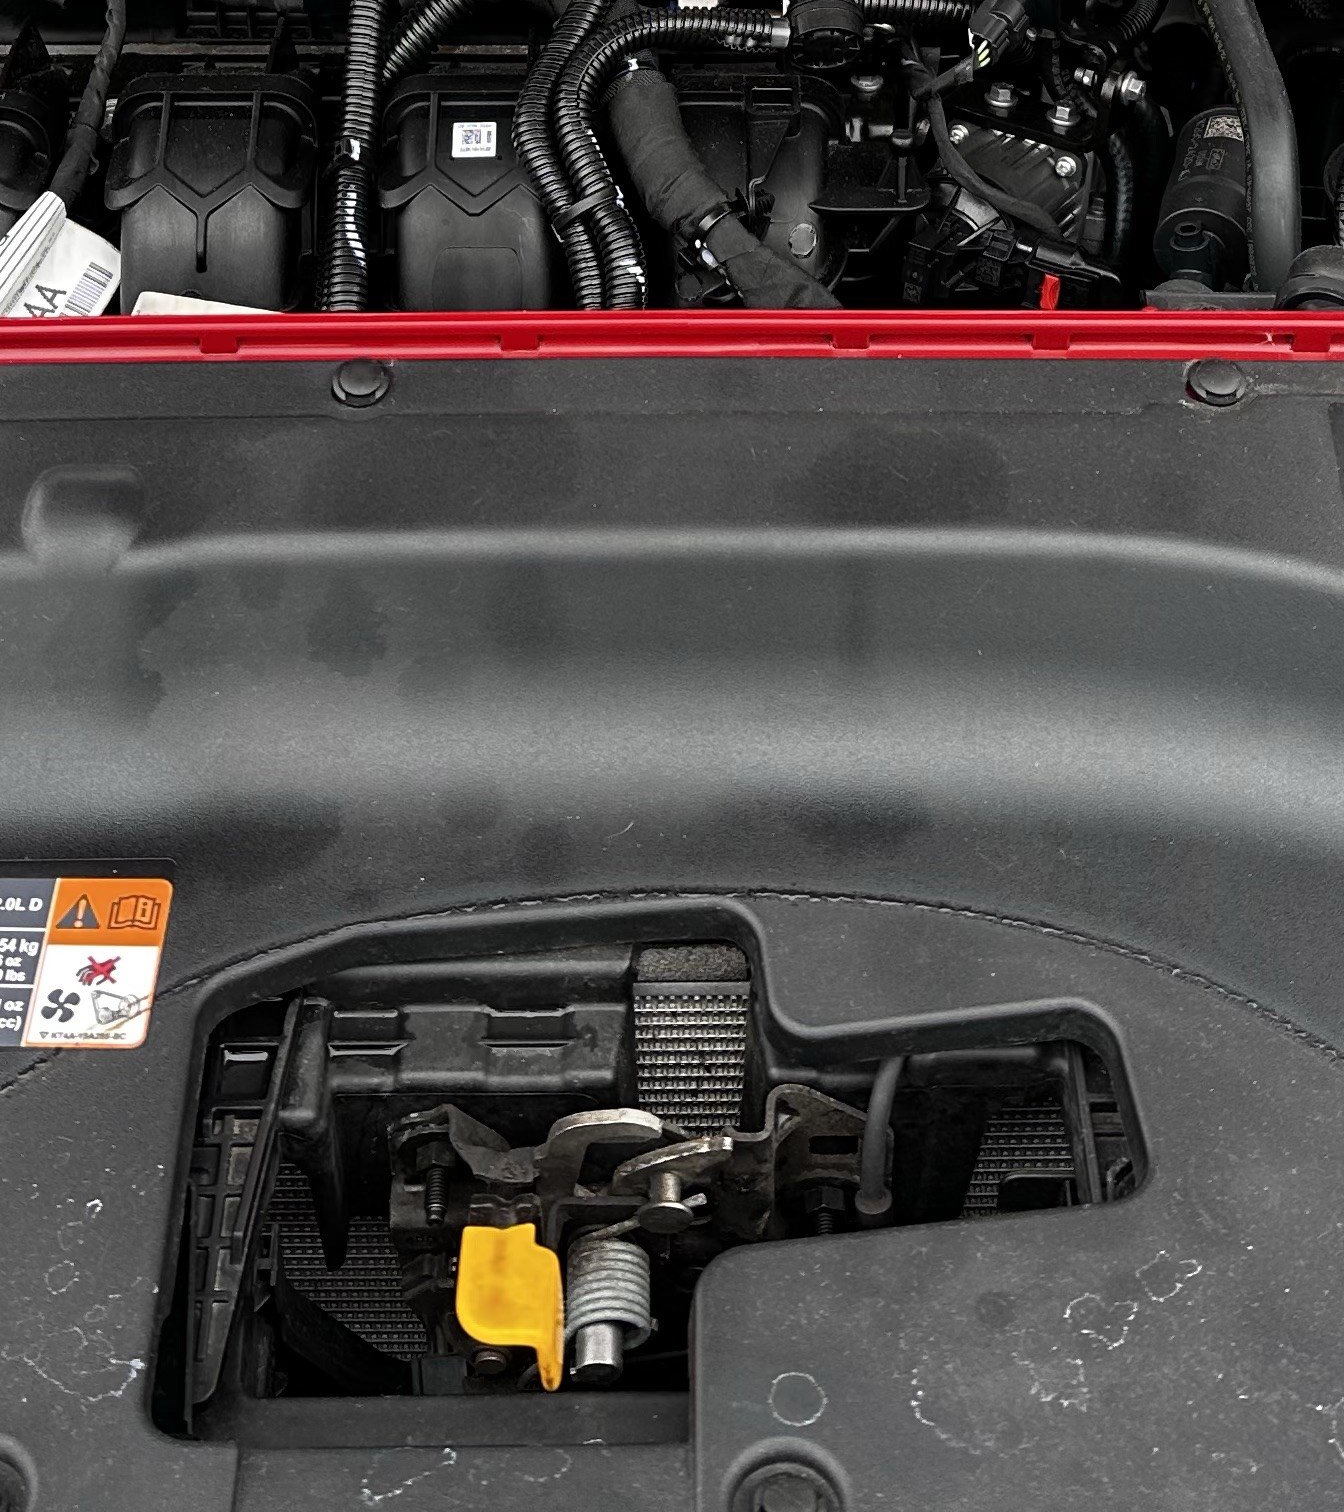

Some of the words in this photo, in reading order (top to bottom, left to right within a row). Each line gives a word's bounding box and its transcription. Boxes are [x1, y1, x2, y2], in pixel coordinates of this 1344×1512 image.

[29, 897, 44, 912] D
[17, 937, 40, 957] kg
[3, 956, 22, 968] oz
[3, 969, 27, 983] lbs
[4, 999, 24, 1012] oz
